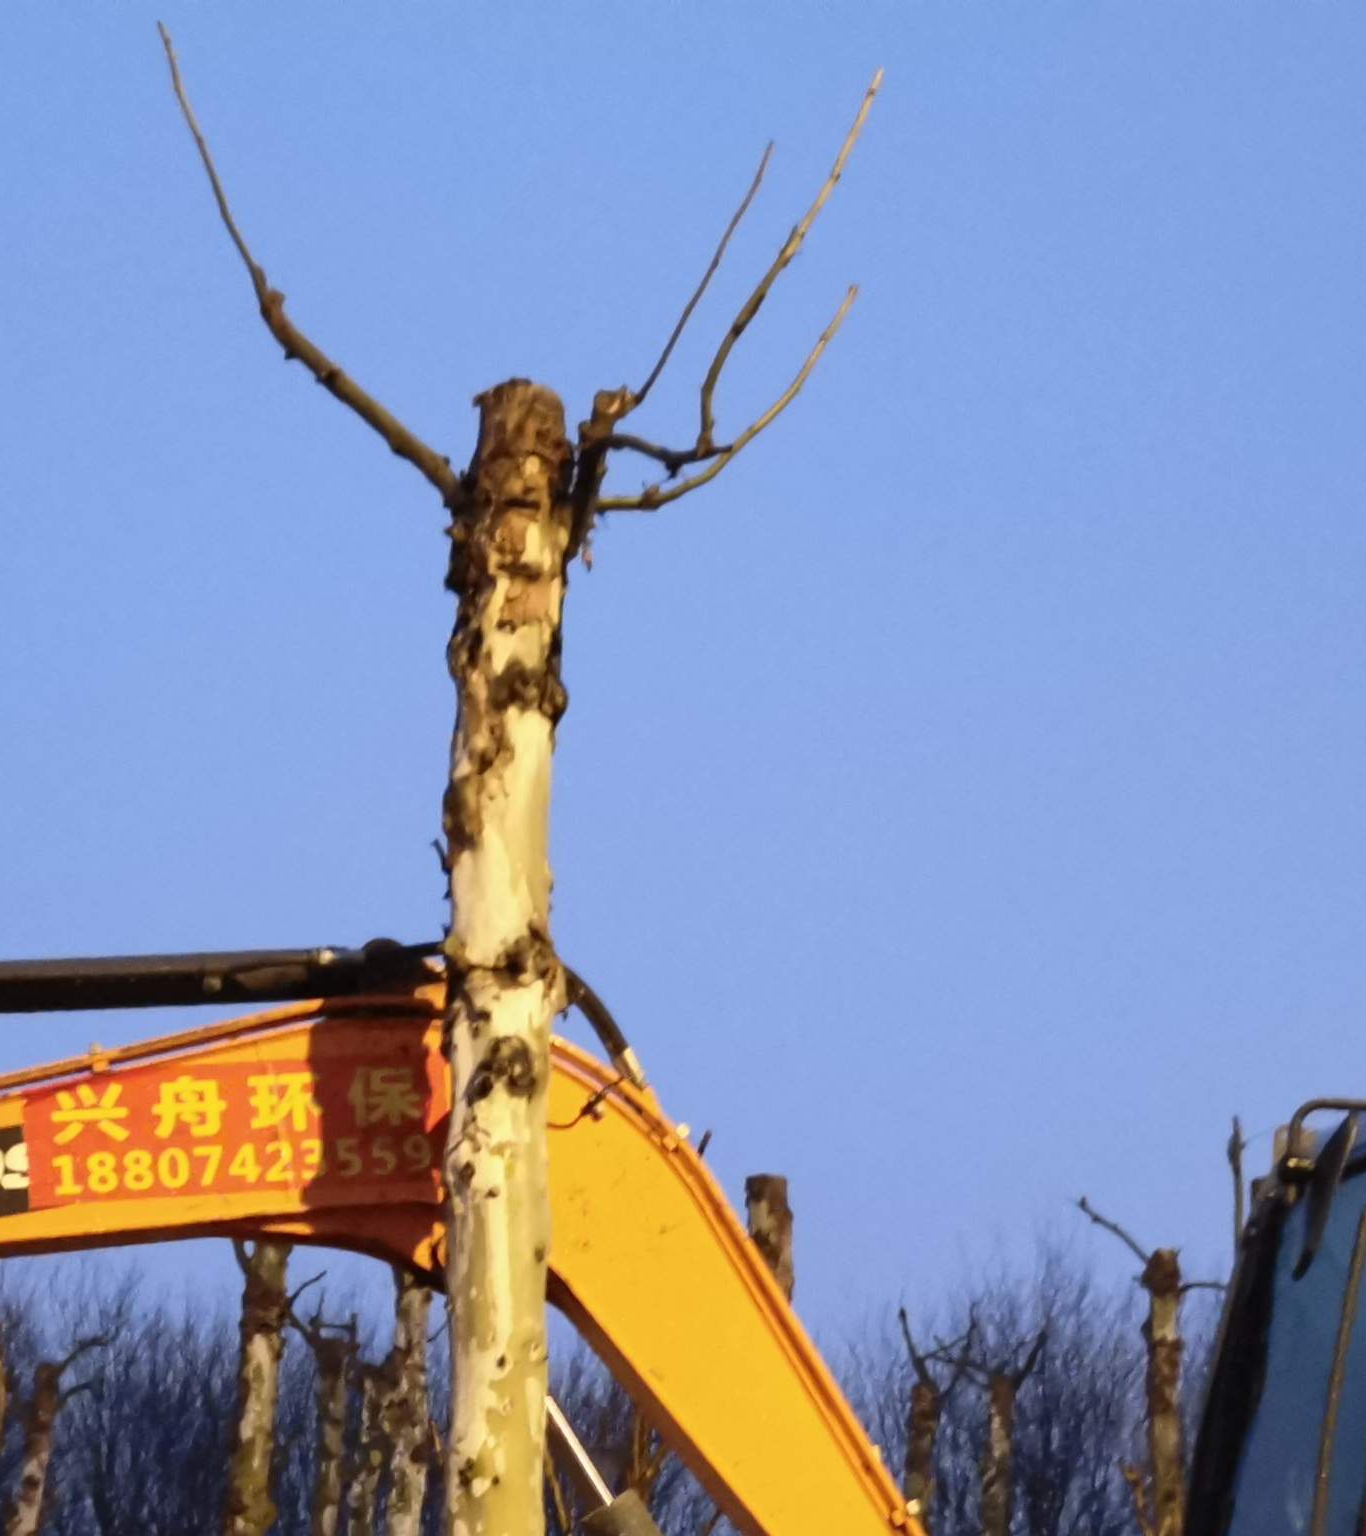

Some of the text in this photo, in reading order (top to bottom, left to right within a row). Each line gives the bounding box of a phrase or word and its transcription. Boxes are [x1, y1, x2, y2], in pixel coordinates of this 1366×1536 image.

[50, 1065, 423, 1146] 兴舟环保
[51, 1133, 433, 1197] 18807423559
